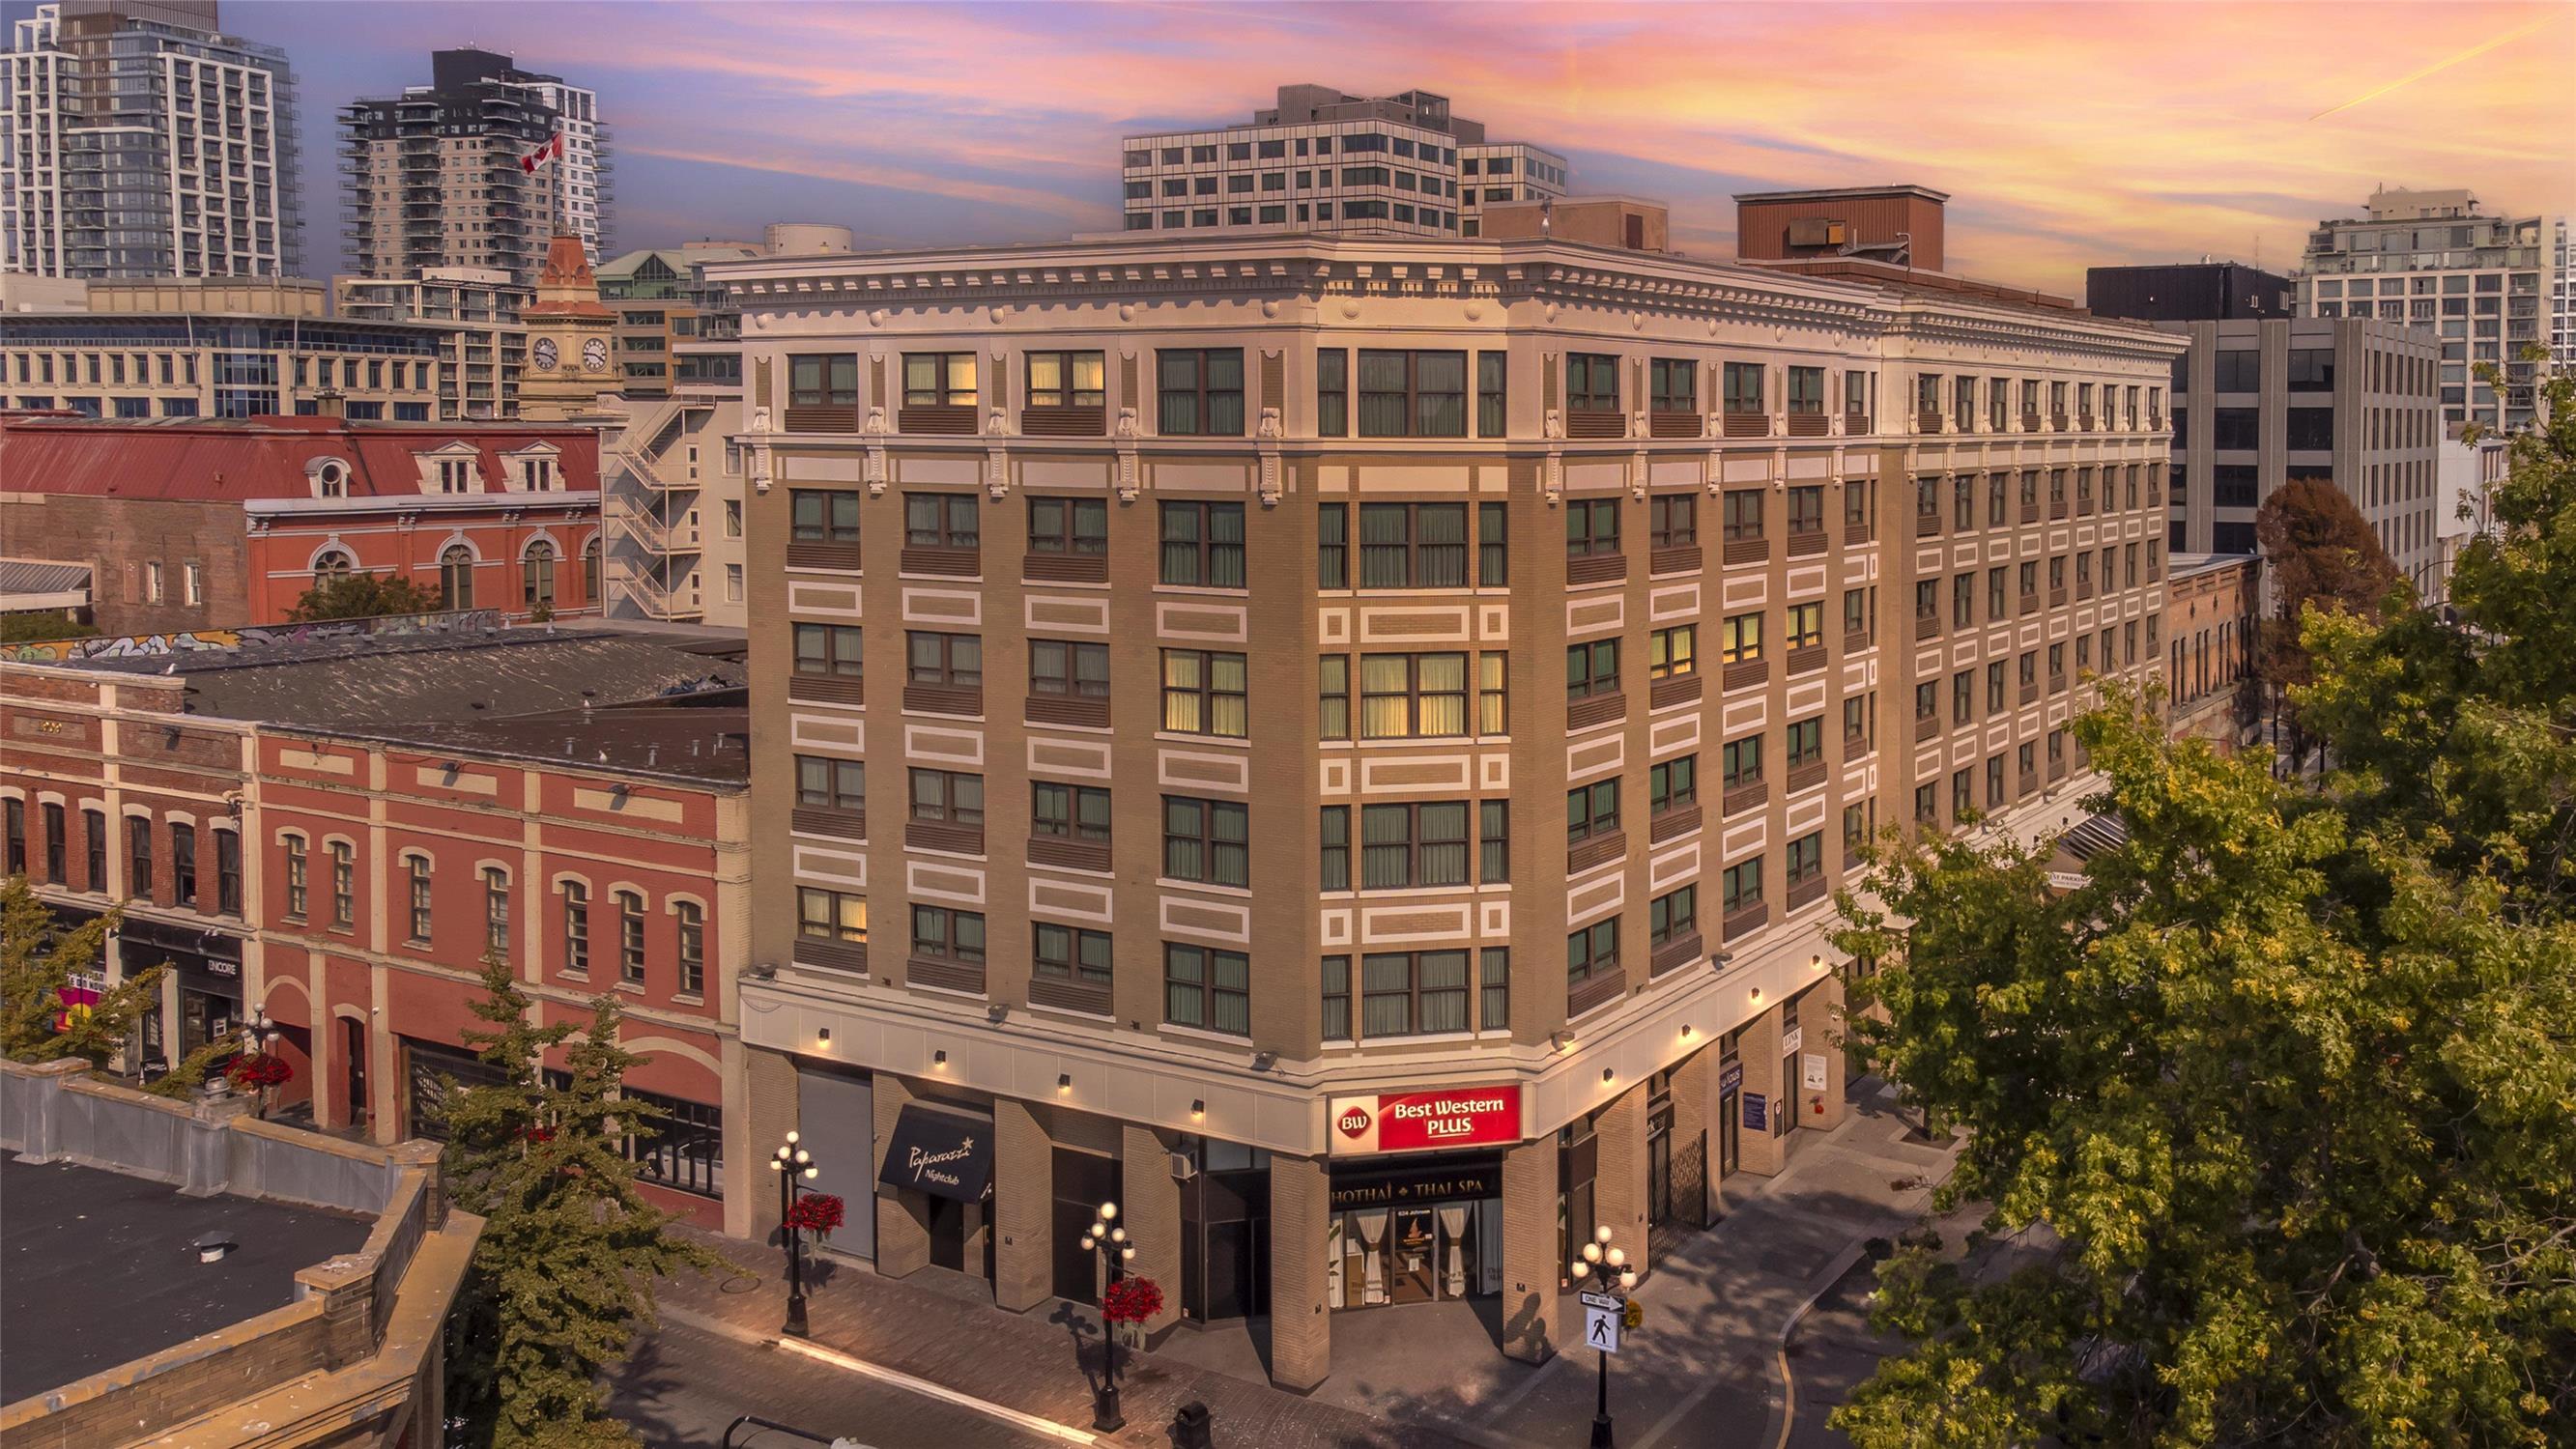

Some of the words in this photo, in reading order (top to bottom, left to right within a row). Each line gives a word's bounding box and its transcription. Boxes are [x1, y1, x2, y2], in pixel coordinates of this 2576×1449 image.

[1394, 1101, 1433, 1120] Best
[1435, 1099, 1504, 1117] Western
[1342, 1117, 1367, 1130] BW
[1427, 1118, 1472, 1135] PLUS
[909, 1146, 970, 1182] Paparazzi
[925, 1169, 959, 1184] Nightclub
[1415, 1182, 1451, 1196] THAI
[1458, 1179, 1484, 1192] SPA
